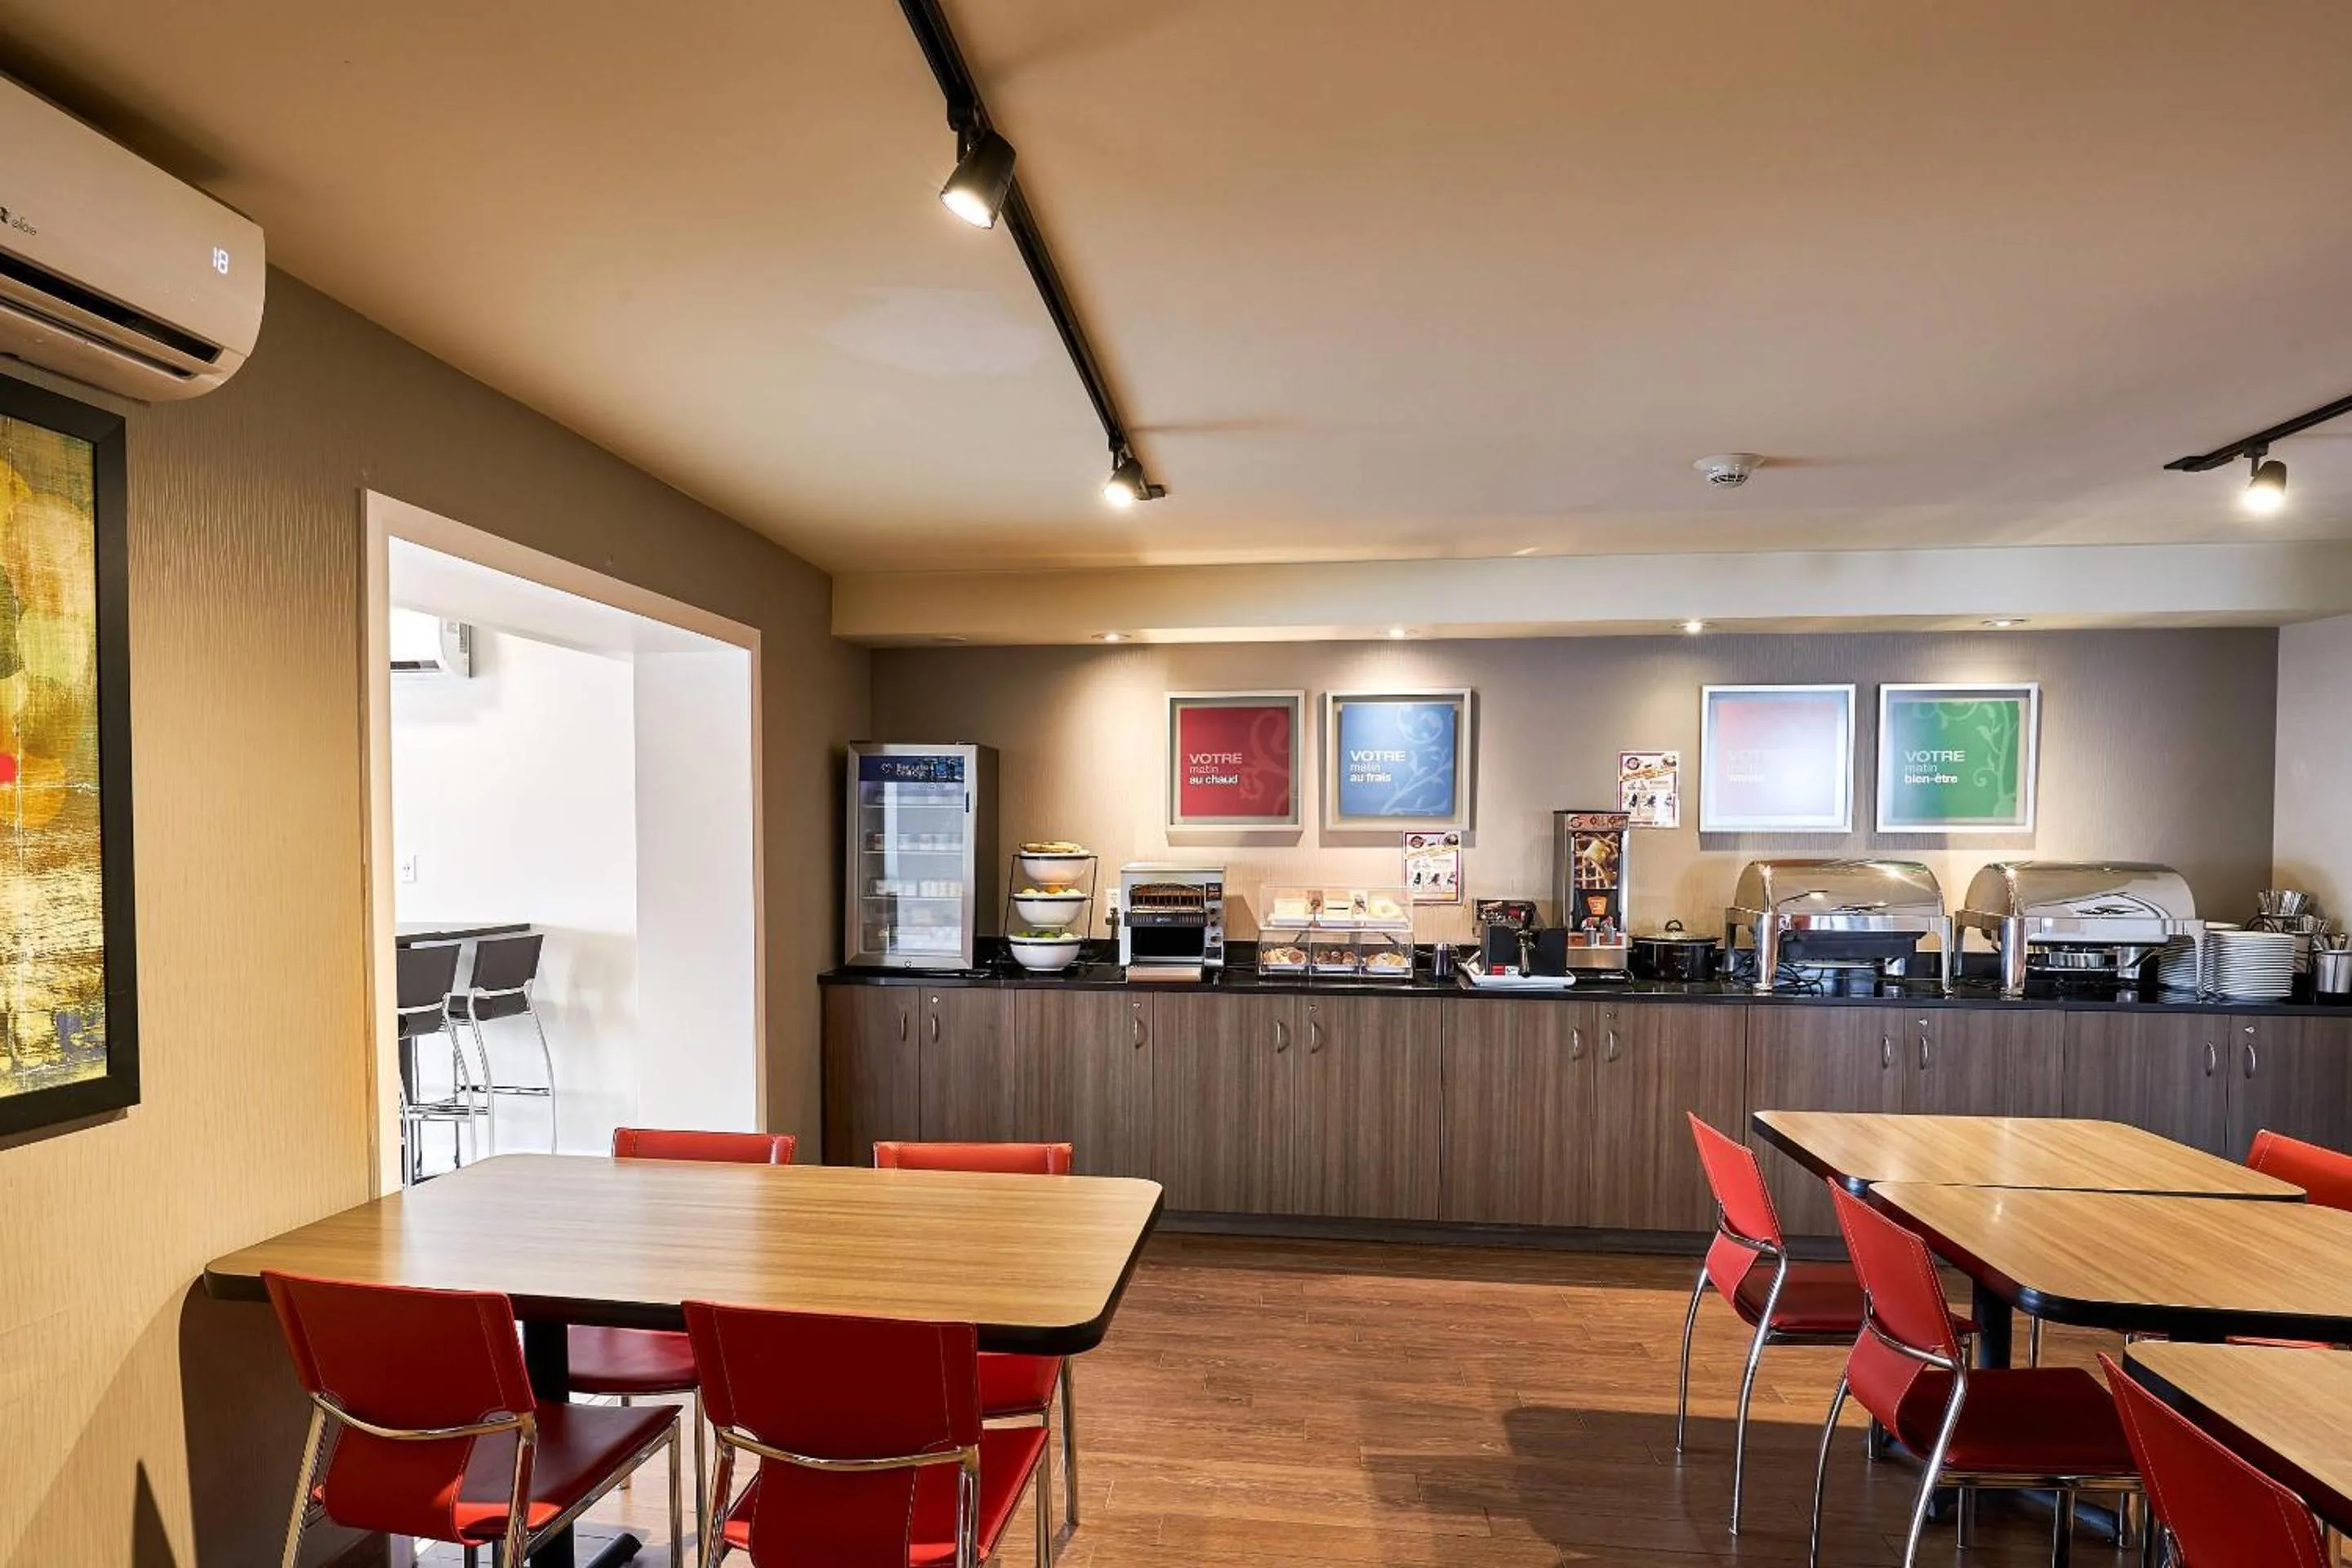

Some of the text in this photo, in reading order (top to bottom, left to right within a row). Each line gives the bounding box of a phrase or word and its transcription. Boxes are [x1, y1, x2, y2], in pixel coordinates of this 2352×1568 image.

[213, 247, 229, 274] 18
[1189, 753, 1243, 764] VOTRE
[1349, 750, 1405, 761] VOTRE
[1904, 751, 1966, 763] VOTRE
[1189, 774, 1238, 785] au chaud
[1350, 773, 1392, 782] au frais
[1904, 773, 1958, 784] bien-être
